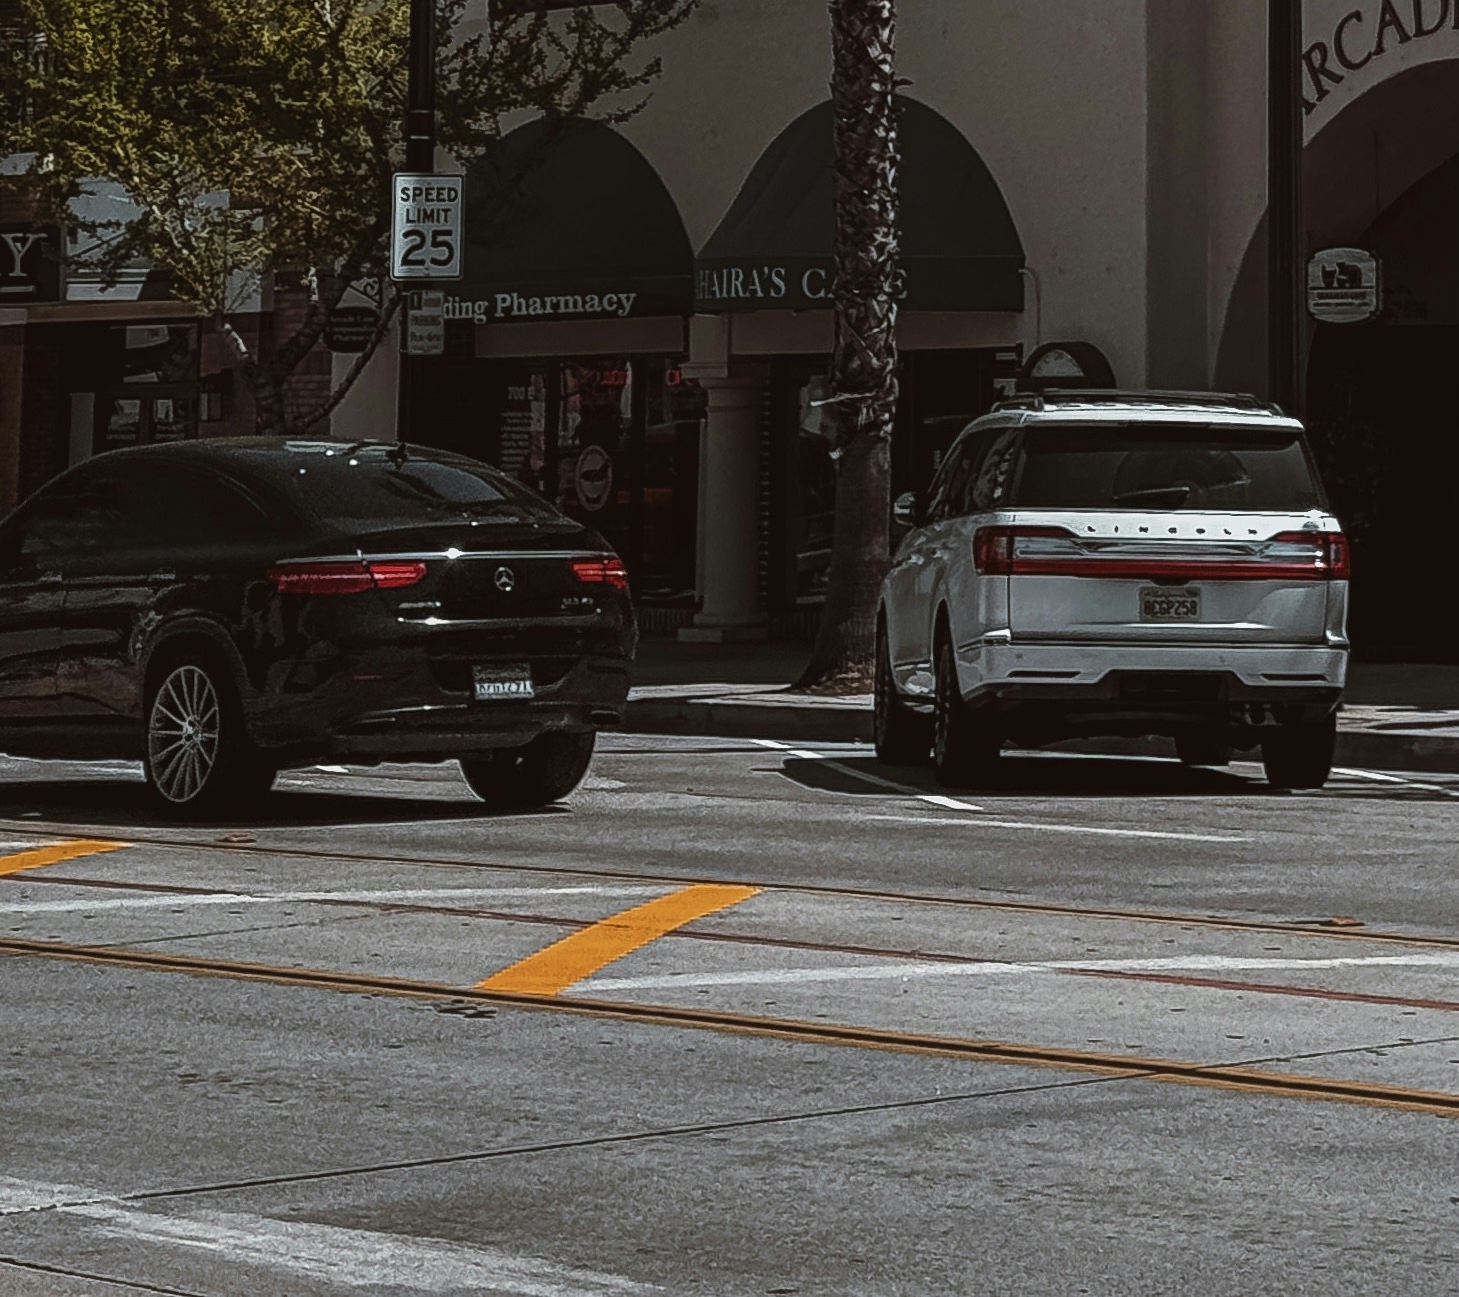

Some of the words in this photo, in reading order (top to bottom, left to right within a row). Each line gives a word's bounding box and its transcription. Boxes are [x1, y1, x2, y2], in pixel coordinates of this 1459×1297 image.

[400, 186, 458, 203] SPEED
[405, 208, 452, 224] LIMIT
[0, 232, 48, 277] Y
[400, 229, 455, 267] 25
[695, 266, 786, 300] HAIRA'S
[443, 295, 488, 324] ding
[493, 291, 637, 317] Pharmacy
